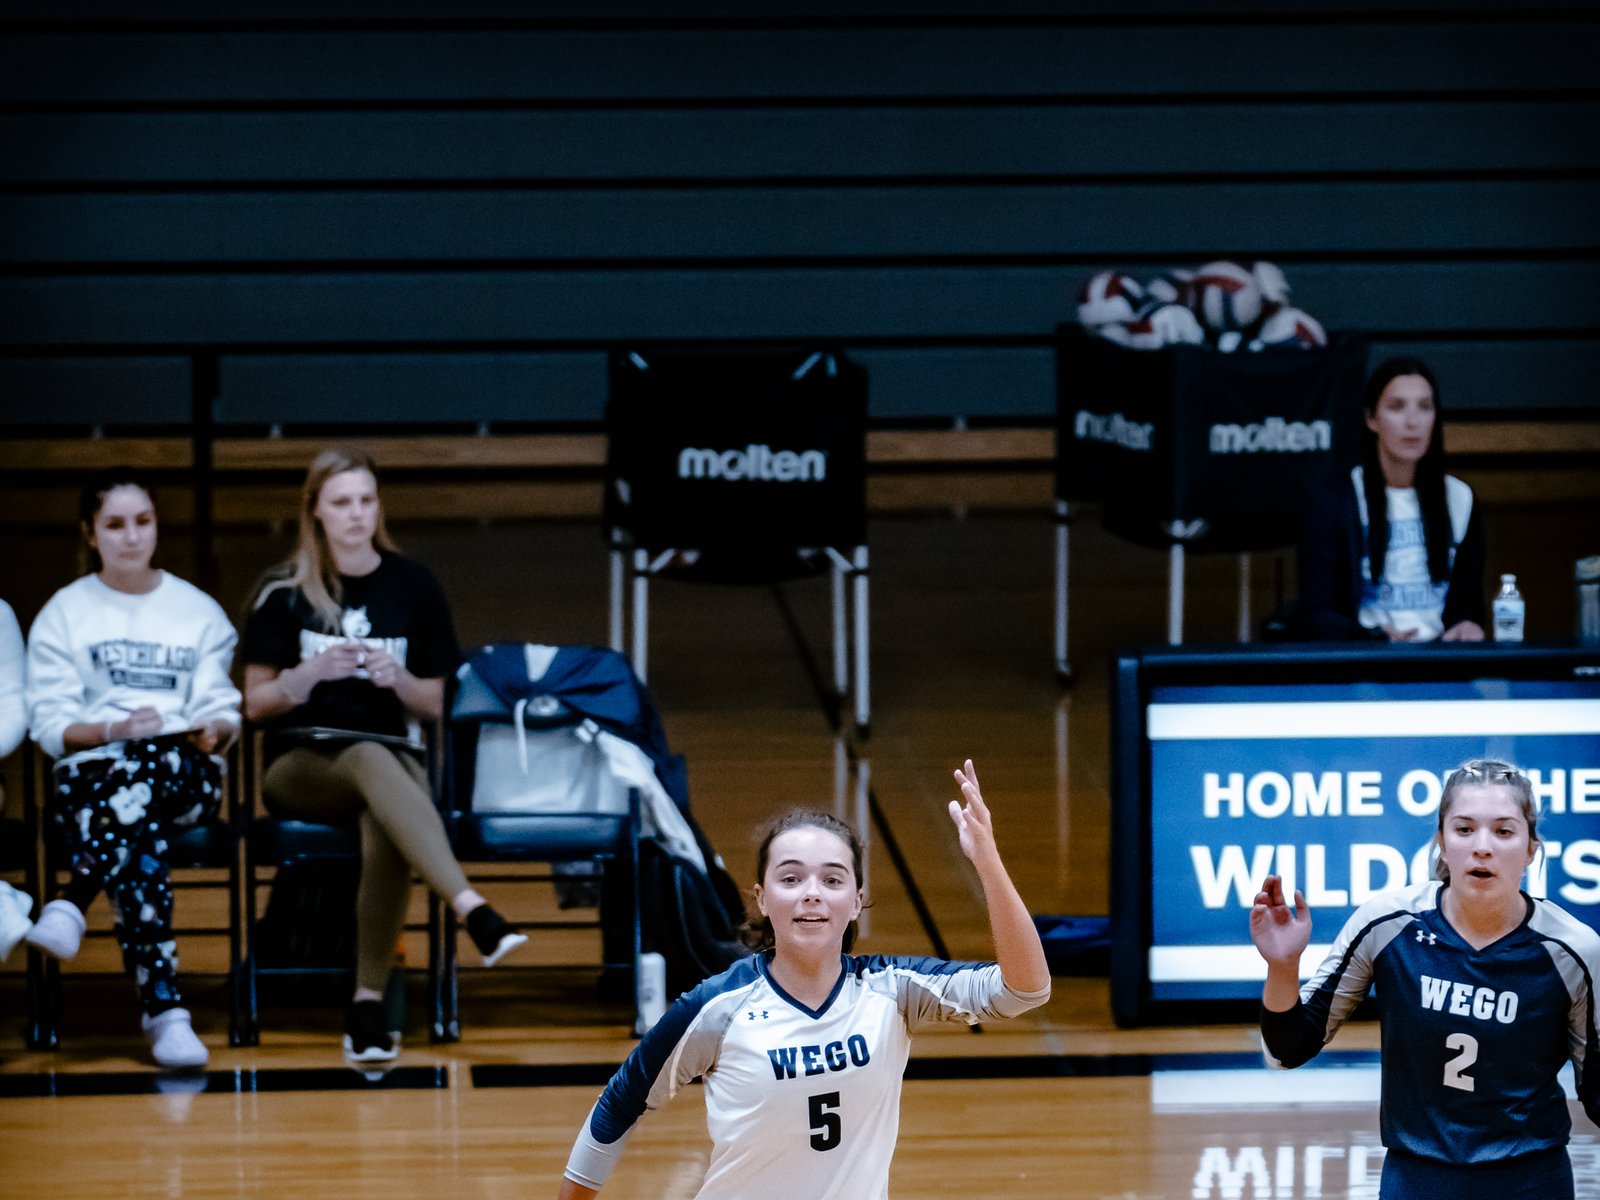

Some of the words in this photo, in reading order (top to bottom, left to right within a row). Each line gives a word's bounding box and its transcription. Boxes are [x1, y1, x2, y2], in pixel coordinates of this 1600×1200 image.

[1209, 415, 1332, 454] molten
[678, 443, 827, 482] molten
[1203, 771, 1384, 819] HOME
[1397, 768, 1455, 817] O
[1520, 767, 1600, 814] HE
[1189, 839, 1600, 909] WILDTS
[1420, 974, 1519, 1024] WEGO
[767, 1033, 871, 1081] WEGO
[1442, 1032, 1479, 1092] 2
[808, 1090, 841, 1152] 5
